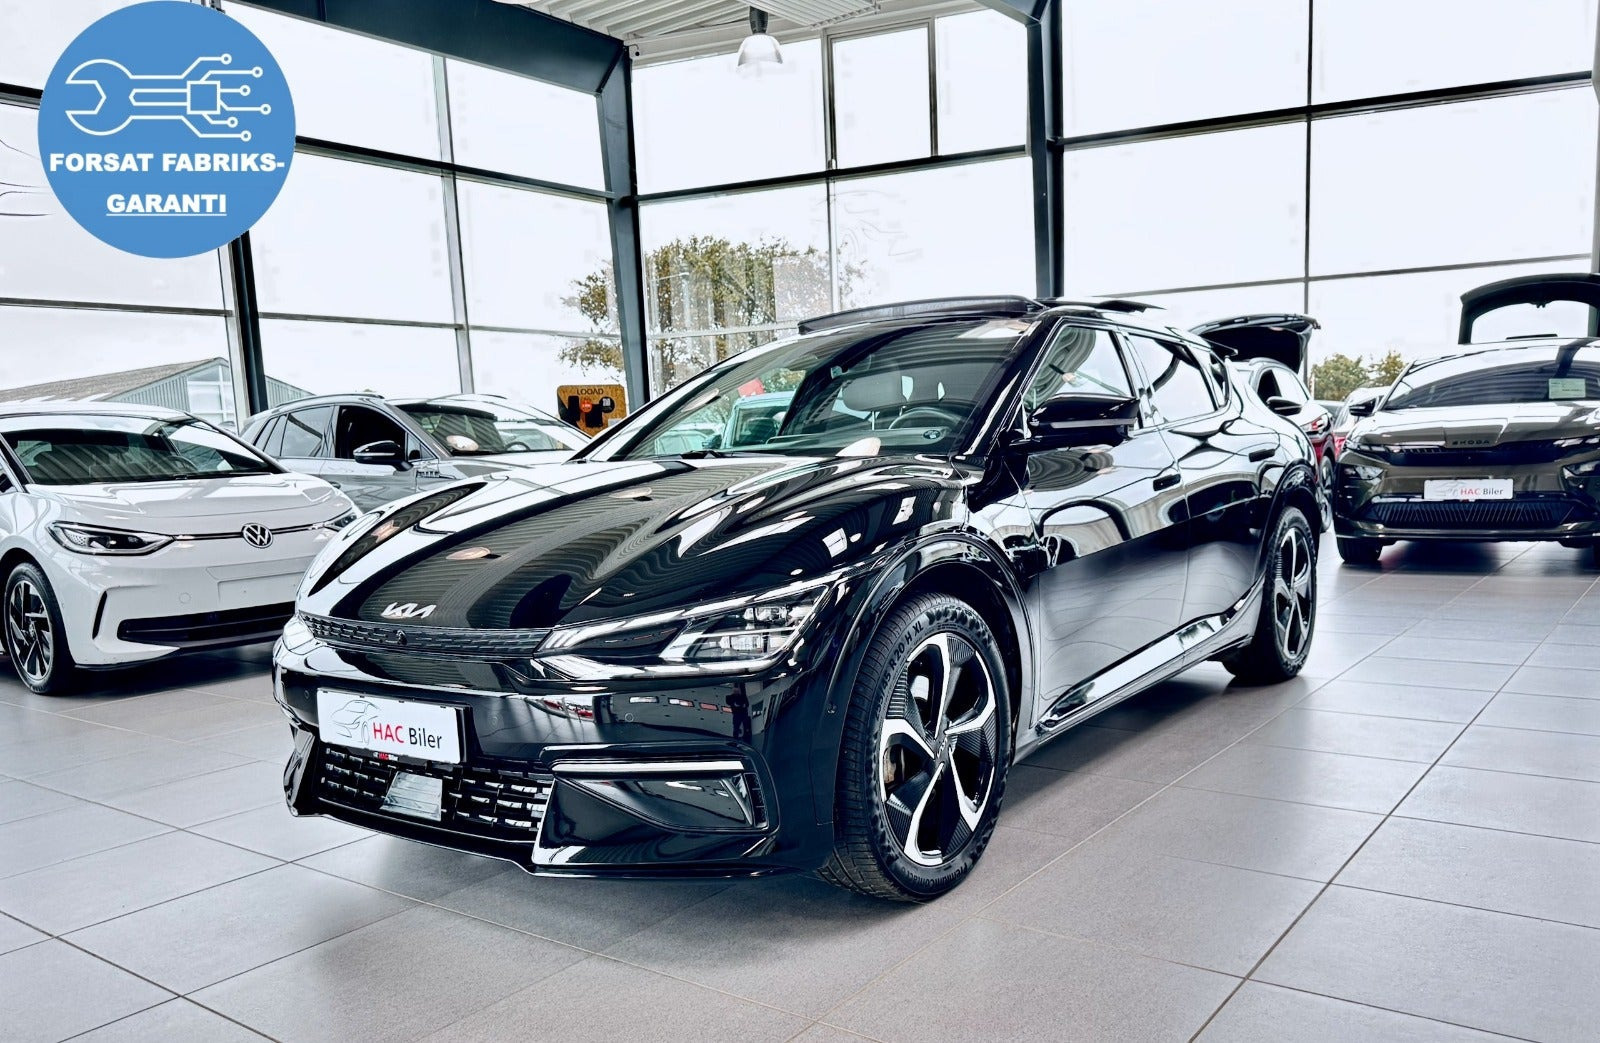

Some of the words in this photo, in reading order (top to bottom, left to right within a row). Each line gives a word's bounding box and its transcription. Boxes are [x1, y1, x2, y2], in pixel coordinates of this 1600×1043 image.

[1460, 488, 1480, 496] HAC
[1483, 487, 1504, 496] Biler
[894, 645, 906, 660] 20
[373, 722, 405, 743] HAC
[408, 727, 443, 749] Biler
